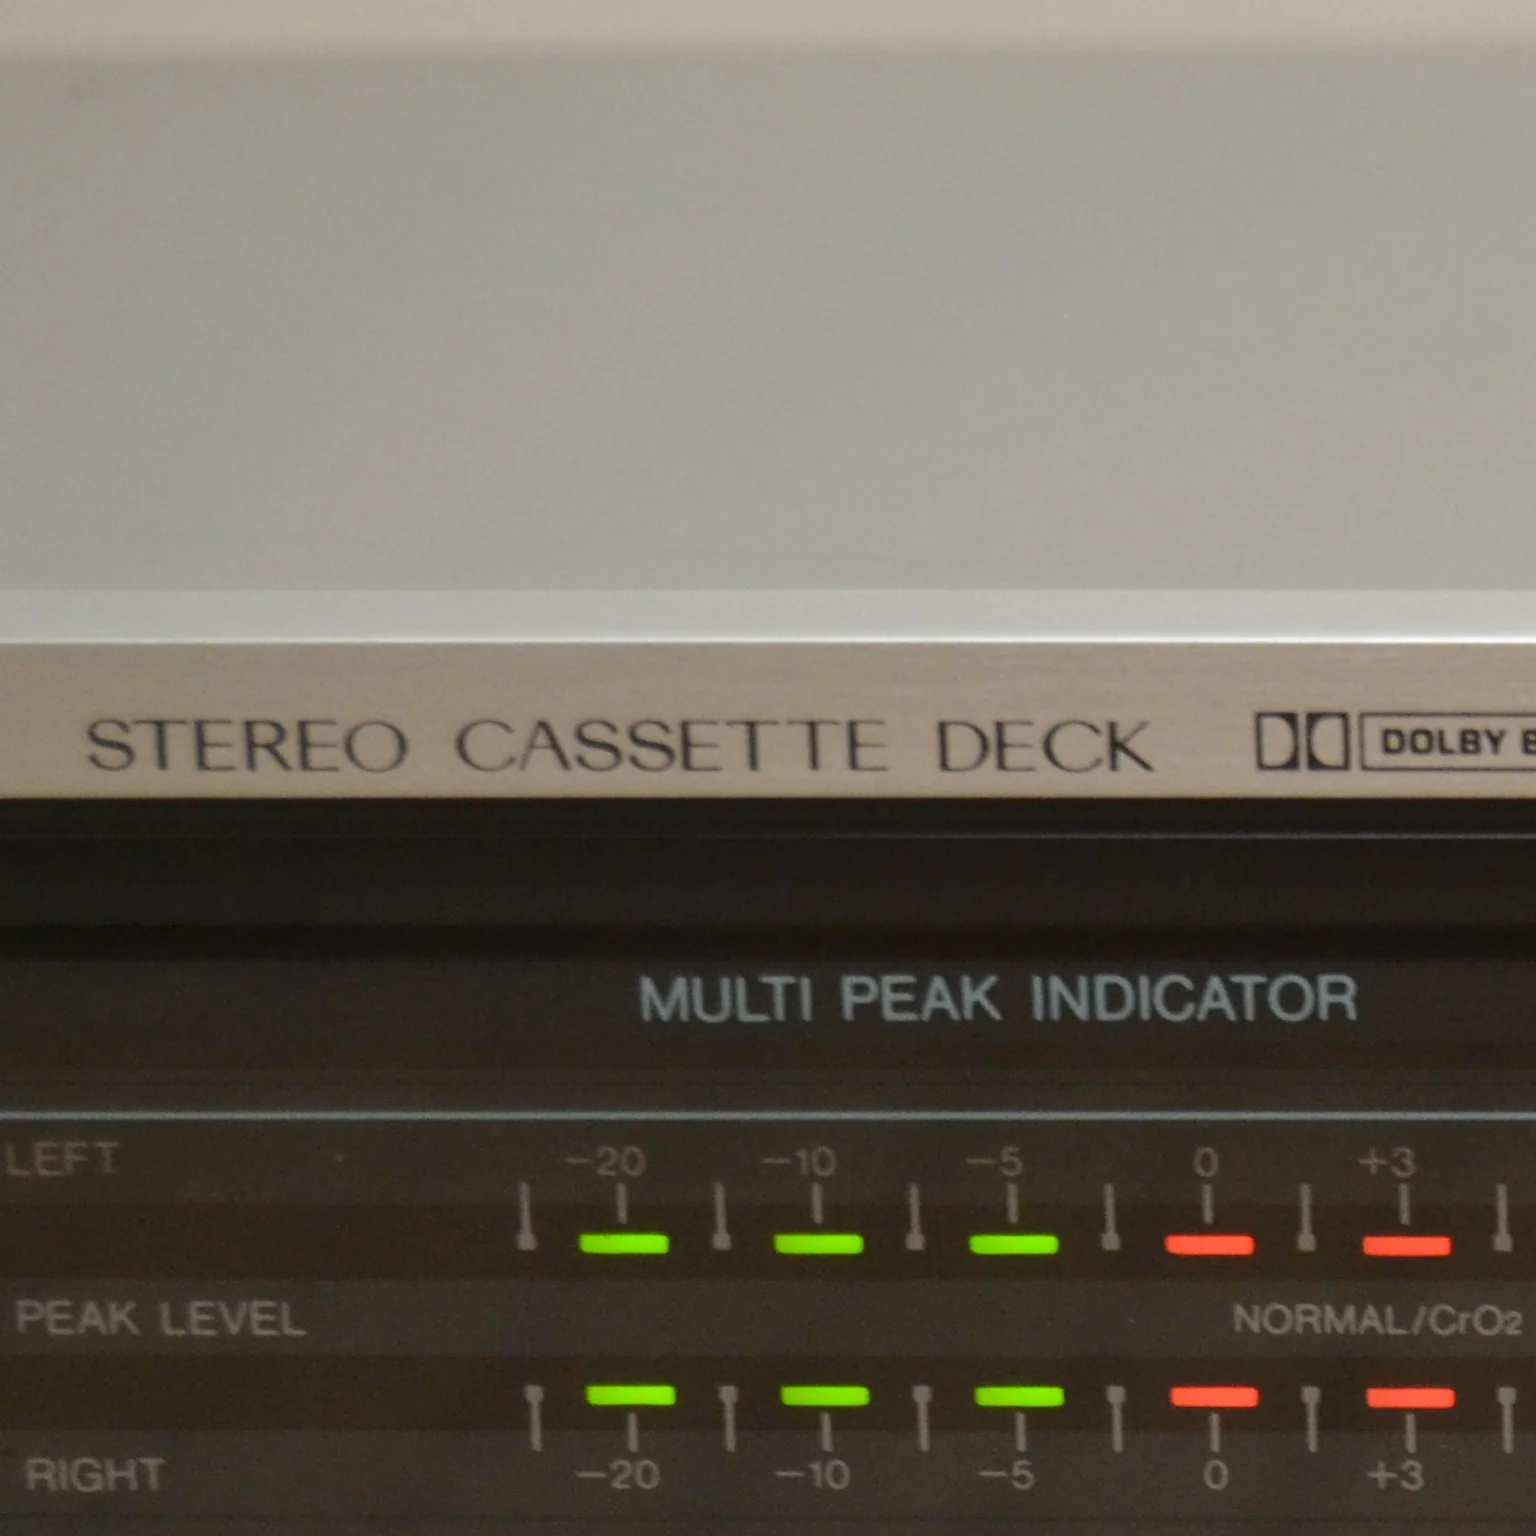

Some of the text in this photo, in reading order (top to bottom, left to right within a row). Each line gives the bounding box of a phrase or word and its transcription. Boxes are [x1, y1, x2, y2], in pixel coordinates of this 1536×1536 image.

[86, 718, 1153, 772] STEREO CASSETTE DECK
[1381, 728, 1506, 755] DOLBY
[640, 974, 1356, 1023] MULTI PEAK INDICATOR
[6, 1141, 118, 1177] LEFT
[1194, 1147, 1219, 1178] 0
[1359, 1147, 1415, 1178] +3
[17, 1299, 306, 1336] PEAK LEVEL
[26, 1457, 164, 1492] RIGHT
[1204, 1459, 1229, 1490] 0
[1367, 1460, 1424, 1491] +3
